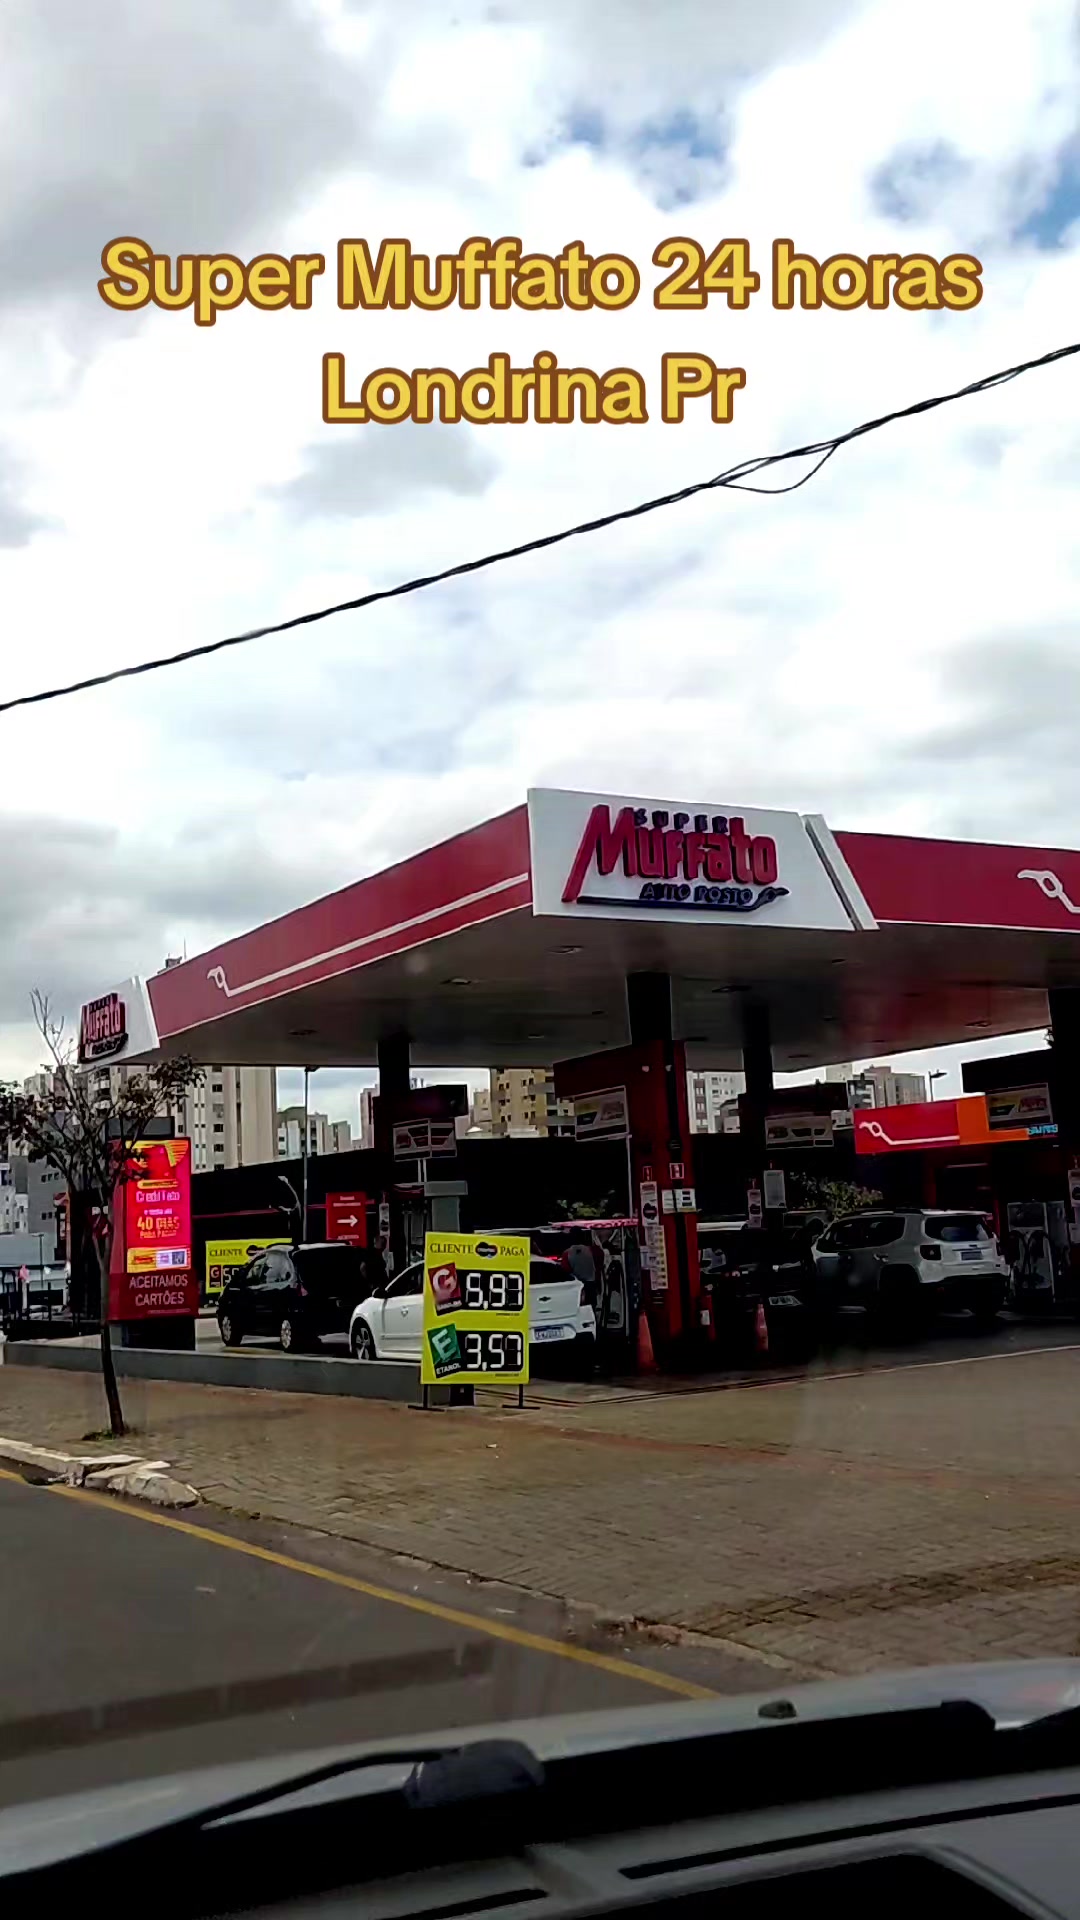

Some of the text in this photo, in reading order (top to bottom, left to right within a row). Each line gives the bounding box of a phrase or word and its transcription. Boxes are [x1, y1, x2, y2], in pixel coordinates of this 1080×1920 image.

[633, 808, 729, 833] SUPER
[561, 804, 778, 903] Muffato
[693, 885, 753, 904] POSTO
[137, 1216, 154, 1231] 40
[209, 1248, 243, 1257] CLIENTE
[430, 1243, 474, 1255] CLIENTE
[500, 1246, 525, 1257] PAGA
[129, 1274, 188, 1290] ACEITAMOS
[432, 1268, 523, 1310] G 5,97
[135, 1289, 185, 1307] CARTÕES
[431, 1328, 522, 1371] E 3,57
